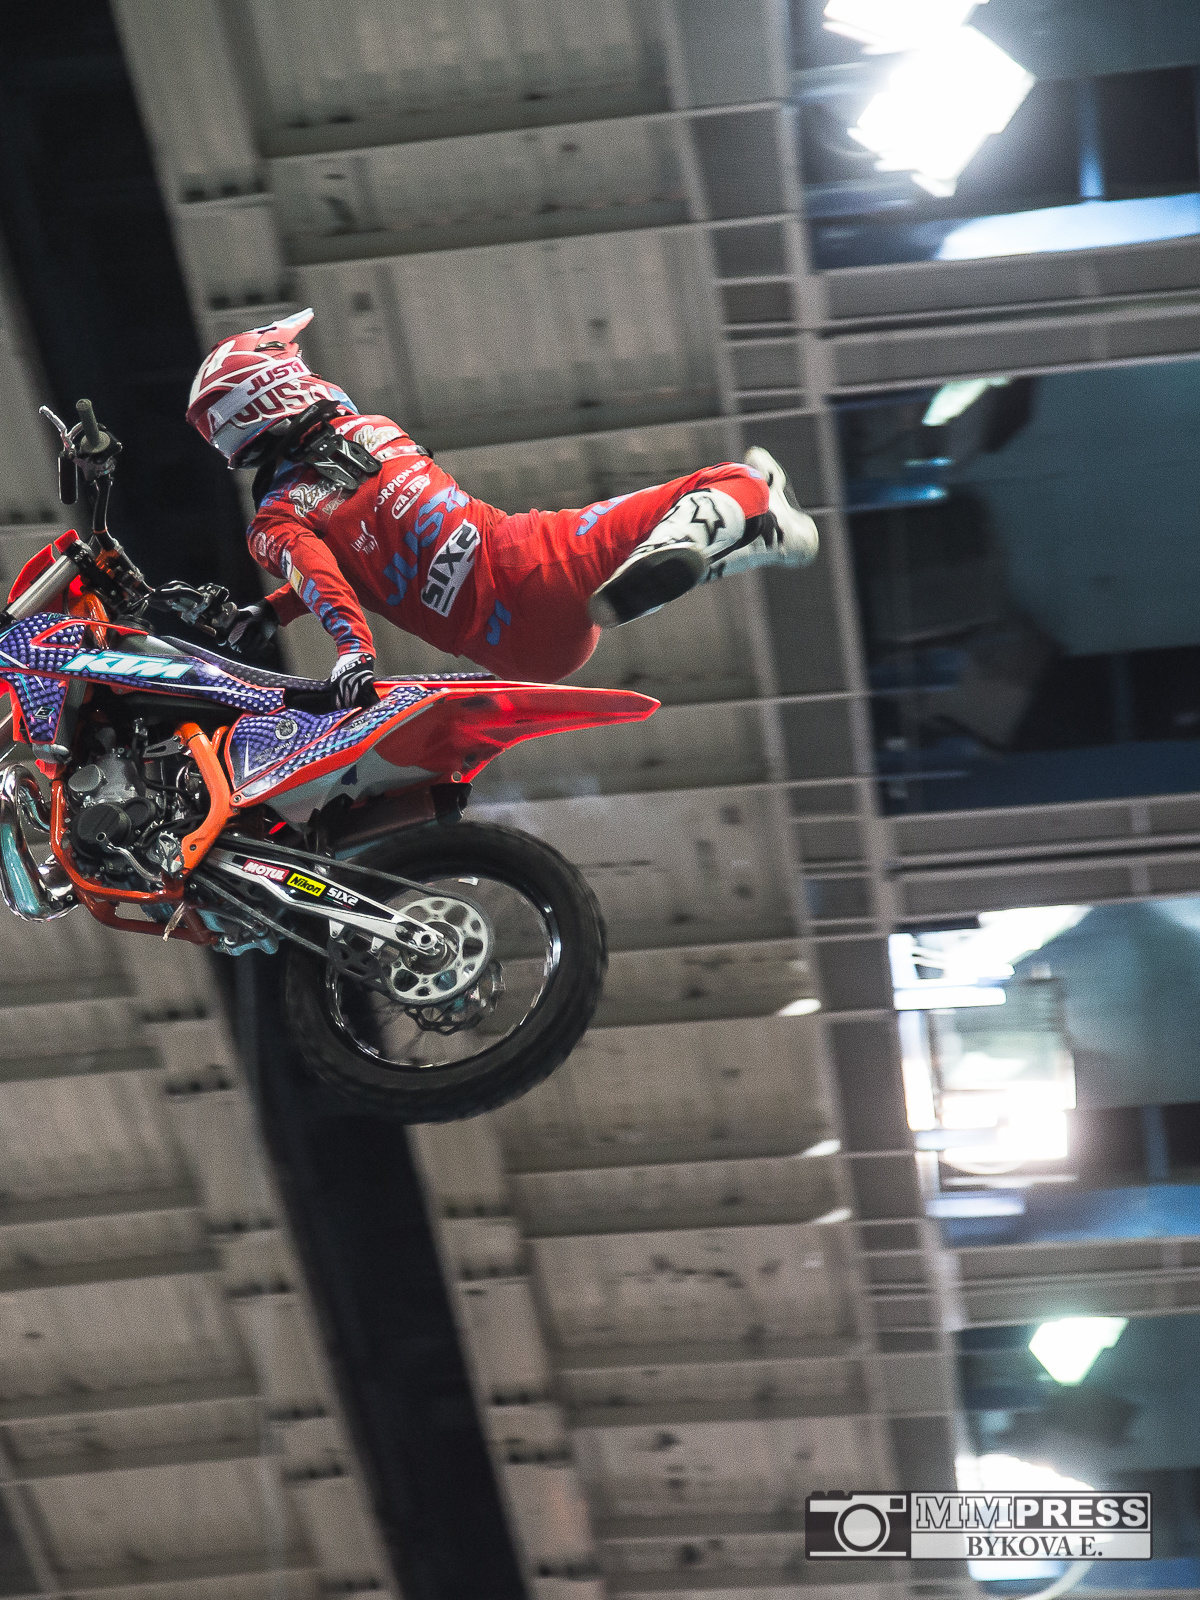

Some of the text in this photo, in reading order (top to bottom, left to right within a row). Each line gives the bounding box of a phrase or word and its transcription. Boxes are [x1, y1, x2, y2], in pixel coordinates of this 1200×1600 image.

[247, 362, 304, 395] JUST1
[374, 467, 413, 513] ORPION
[422, 522, 478, 609] SIX2
[60, 652, 192, 678] KTM
[244, 861, 286, 880] MOTUL
[290, 875, 322, 895] Nikon
[326, 887, 359, 906] SIX2
